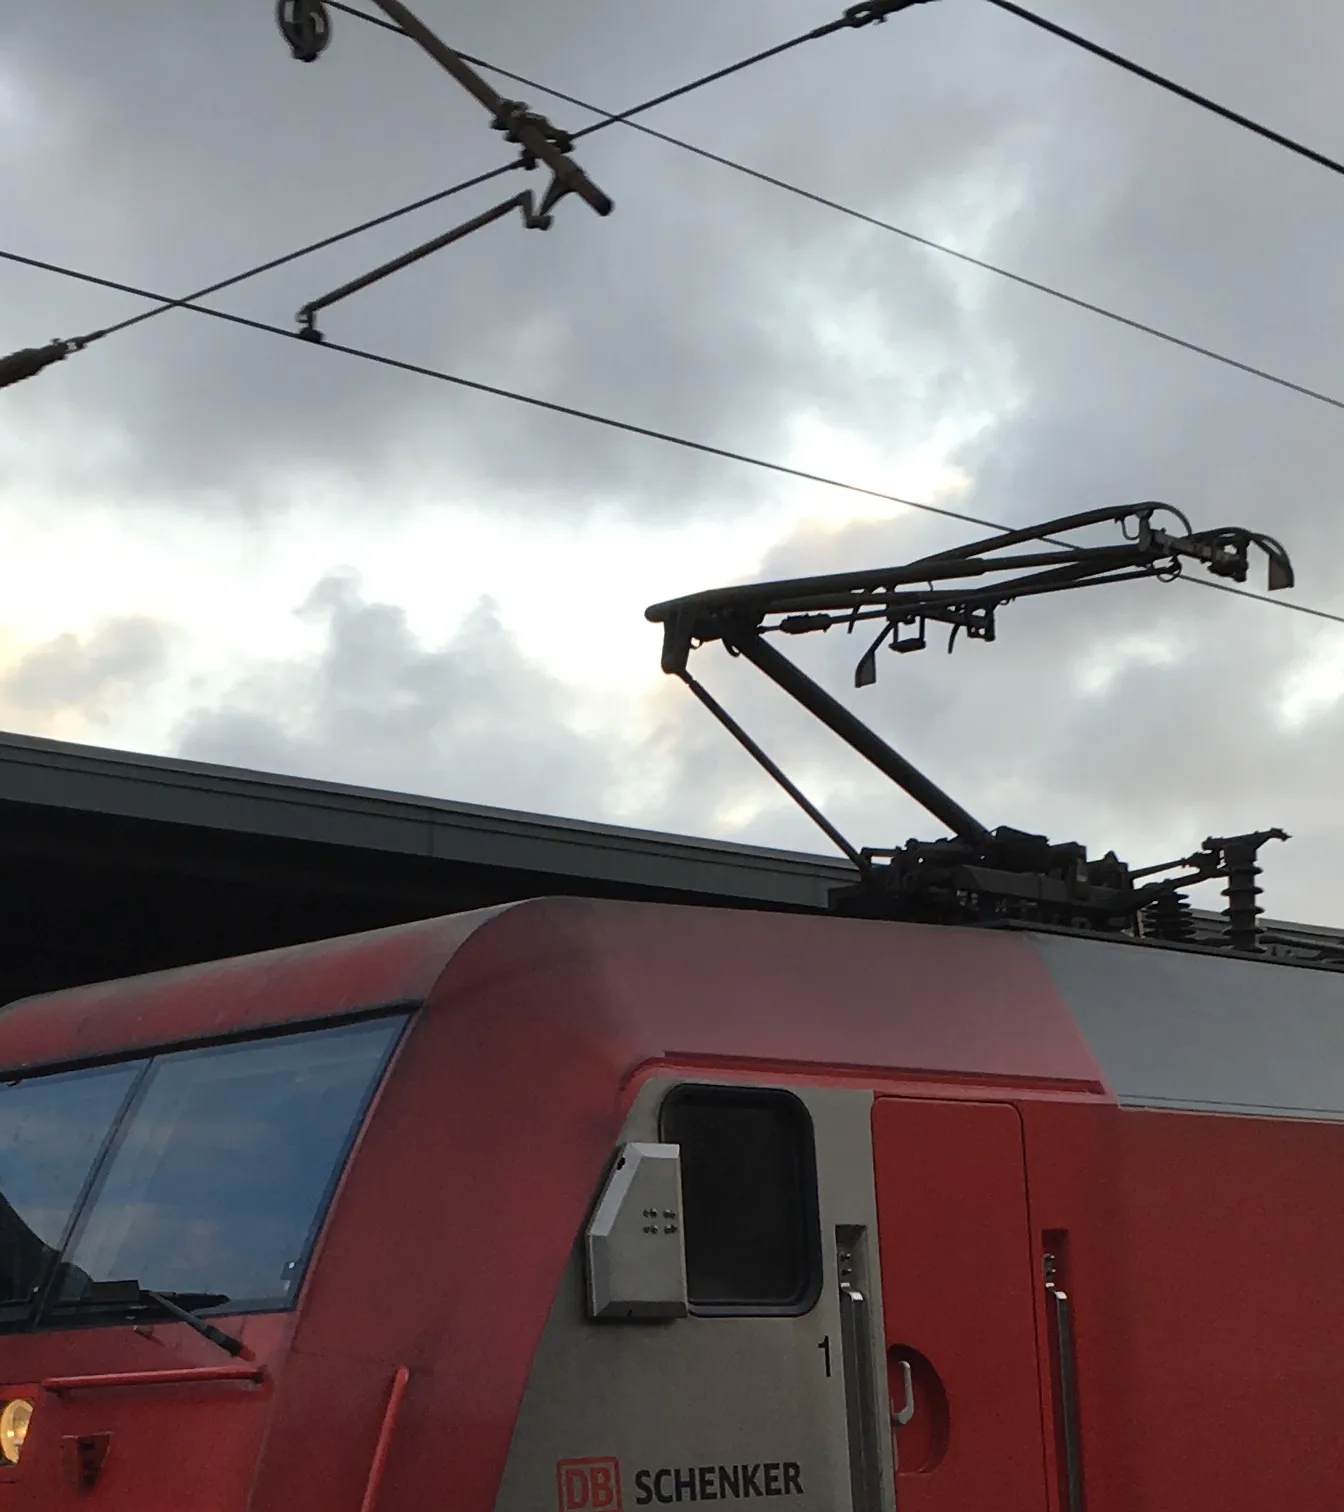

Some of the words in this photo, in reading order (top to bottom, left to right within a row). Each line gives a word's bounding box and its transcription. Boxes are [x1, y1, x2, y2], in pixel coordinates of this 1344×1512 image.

[817, 1336, 831, 1377] 1
[565, 1467, 613, 1510] DB
[635, 1462, 804, 1505] SCHENKER
